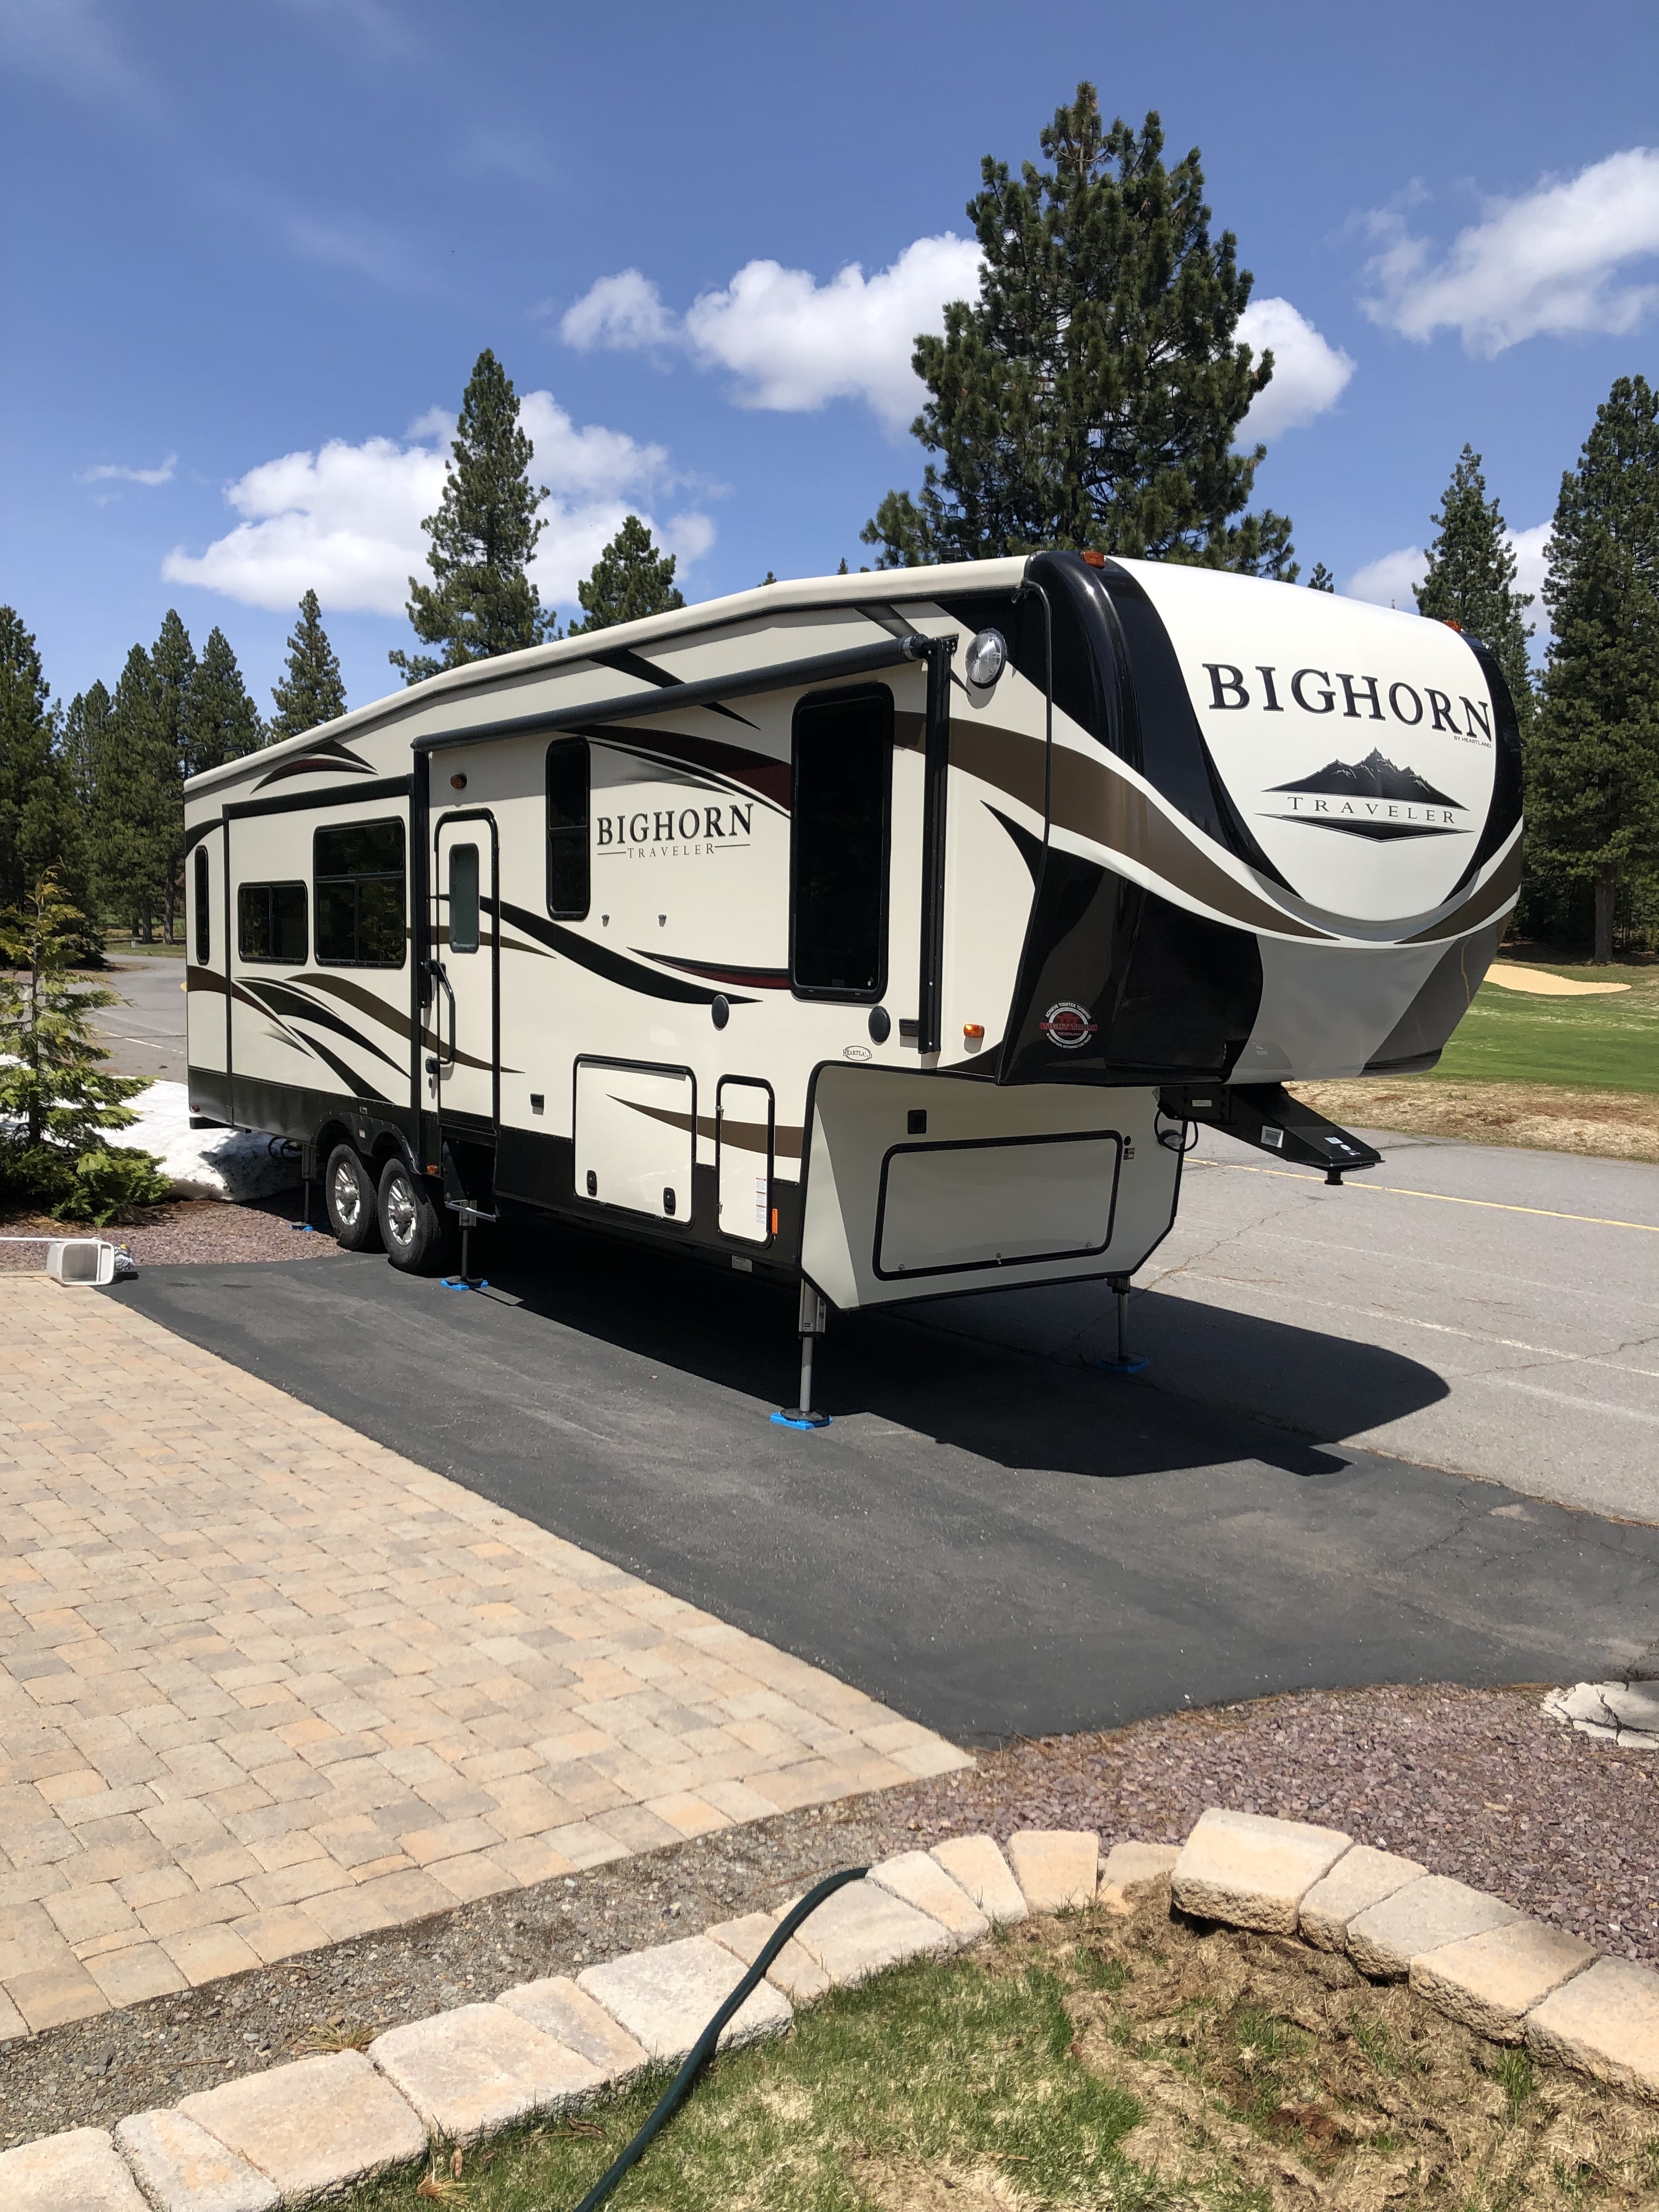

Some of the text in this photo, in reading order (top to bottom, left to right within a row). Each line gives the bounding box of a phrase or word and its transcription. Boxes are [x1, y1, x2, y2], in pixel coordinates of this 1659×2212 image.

[1201, 663, 1492, 742] BIGHORN
[1462, 737, 1491, 748] HEARTLAND
[1287, 796, 1455, 824] TRAVELER
[596, 803, 754, 846] BIGHORN
[627, 842, 715, 859] TRAVELER
[1045, 1004, 1059, 1018] ACHIEVE
[1077, 1005, 1091, 1019] TURNING
